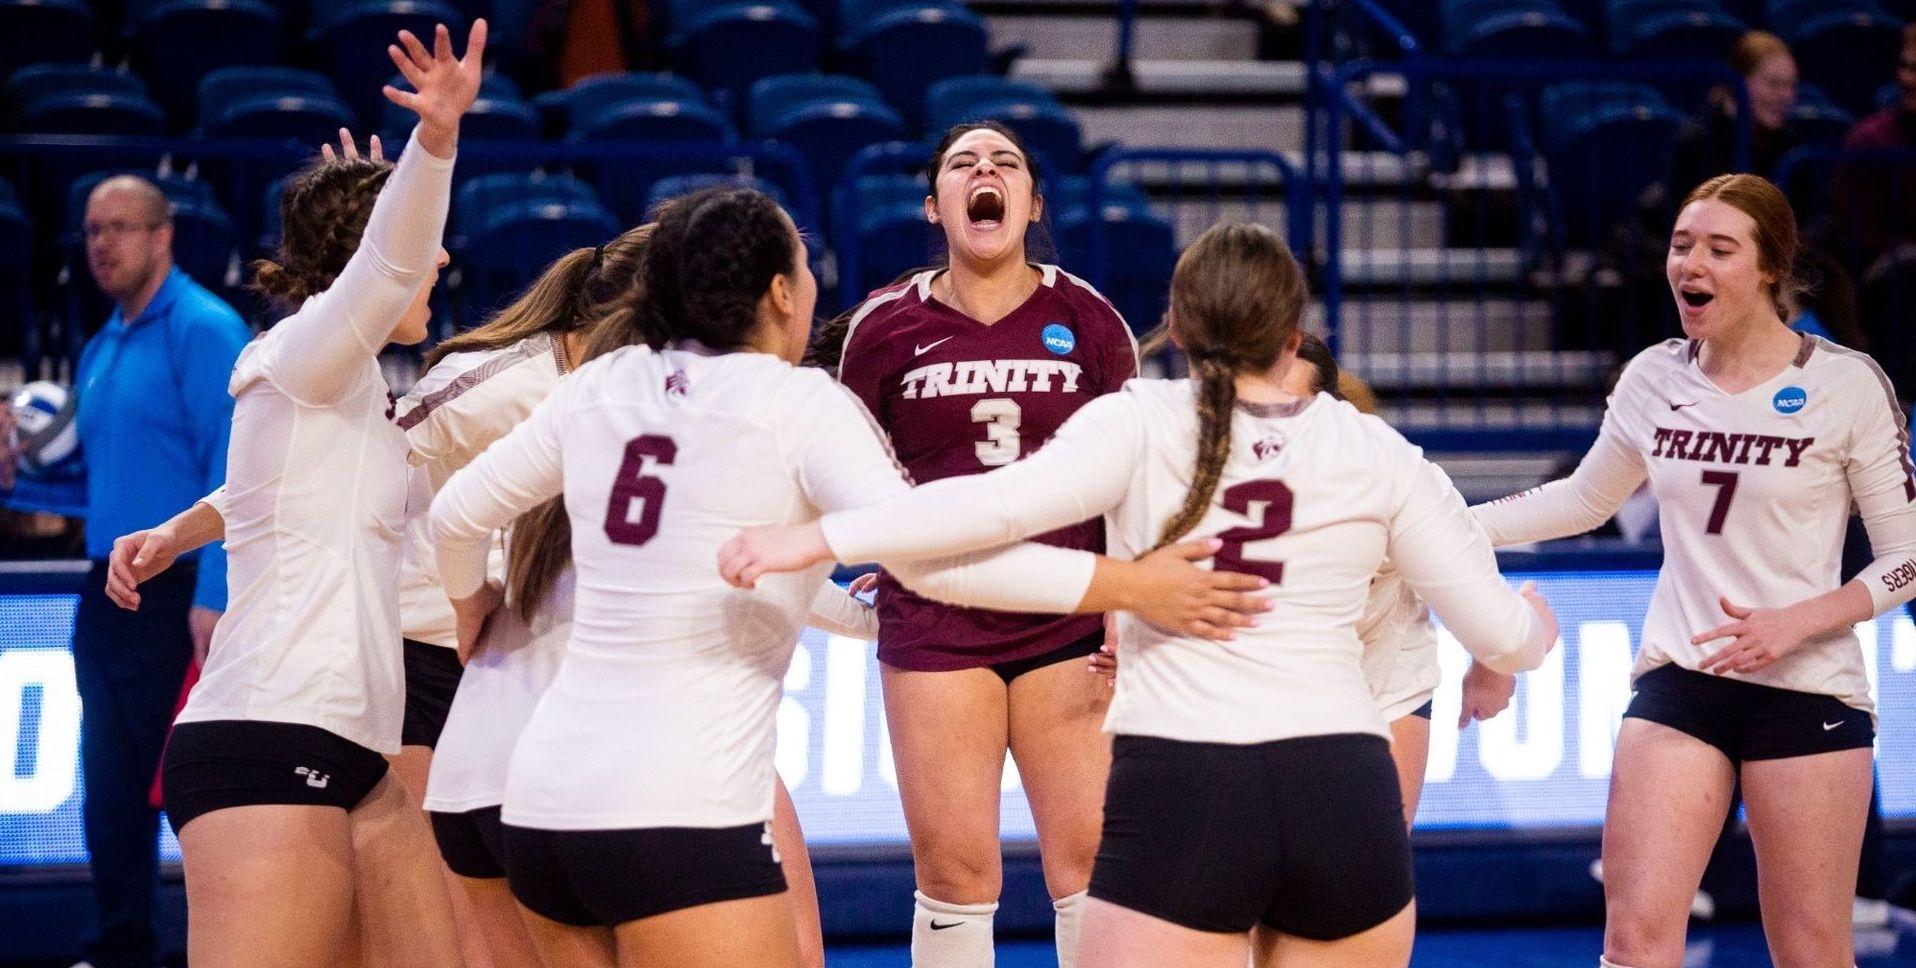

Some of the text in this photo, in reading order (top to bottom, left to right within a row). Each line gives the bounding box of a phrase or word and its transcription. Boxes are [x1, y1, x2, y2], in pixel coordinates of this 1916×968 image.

[1046, 337, 1073, 348] NCAA
[900, 359, 1083, 399] TRINITY
[1776, 398, 1804, 408] NCAA
[970, 398, 1022, 467] 3
[1651, 427, 1815, 468] TRINITY
[603, 433, 678, 546] 6
[1701, 470, 1740, 536] 7
[1212, 478, 1294, 585] 2
